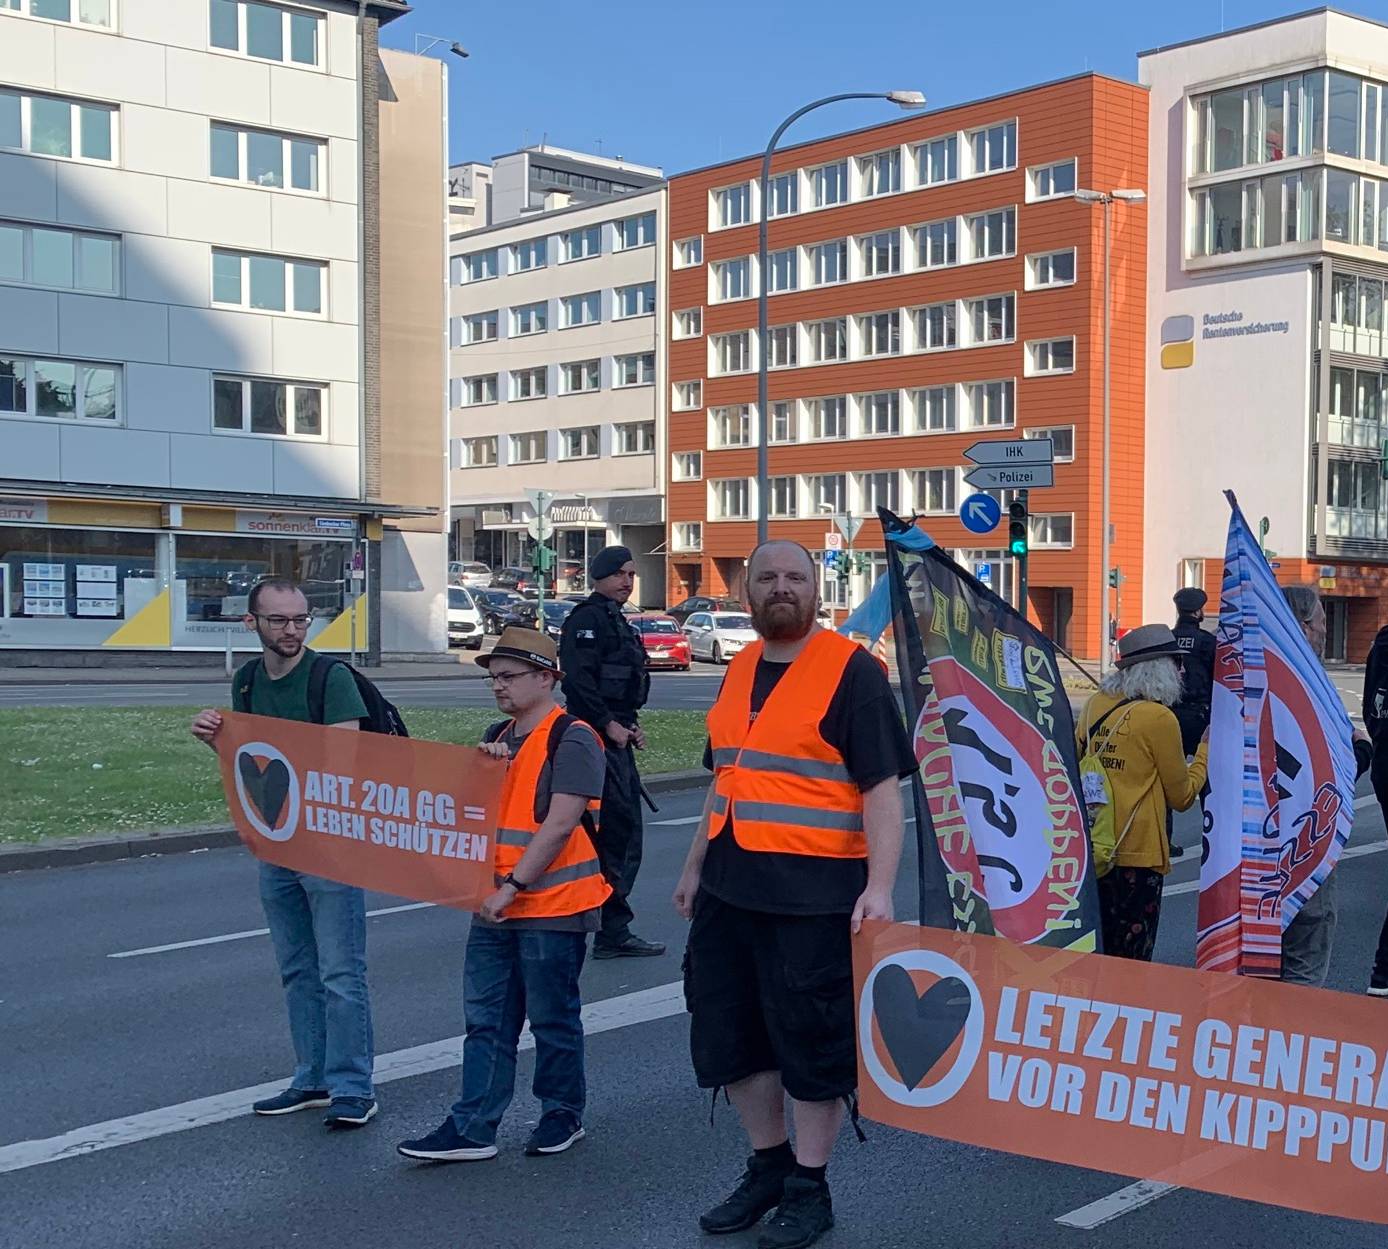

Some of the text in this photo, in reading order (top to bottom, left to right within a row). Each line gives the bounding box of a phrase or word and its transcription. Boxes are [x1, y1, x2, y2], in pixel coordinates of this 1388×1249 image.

[1202, 320, 1289, 339] Rentenversicherung
[1203, 310, 1243, 325] Deutsche
[1005, 446, 1024, 457] IHK
[999, 470, 1033, 483] Polizei
[304, 770, 358, 809] ART.
[361, 780, 411, 820] 20A
[416, 787, 456, 826] GG
[305, 805, 488, 863] LEBEN SCHÜTZEN
[993, 985, 1182, 1073] LETZTE
[987, 1050, 1084, 1115] VOR
[1095, 1069, 1191, 1136] DEN
